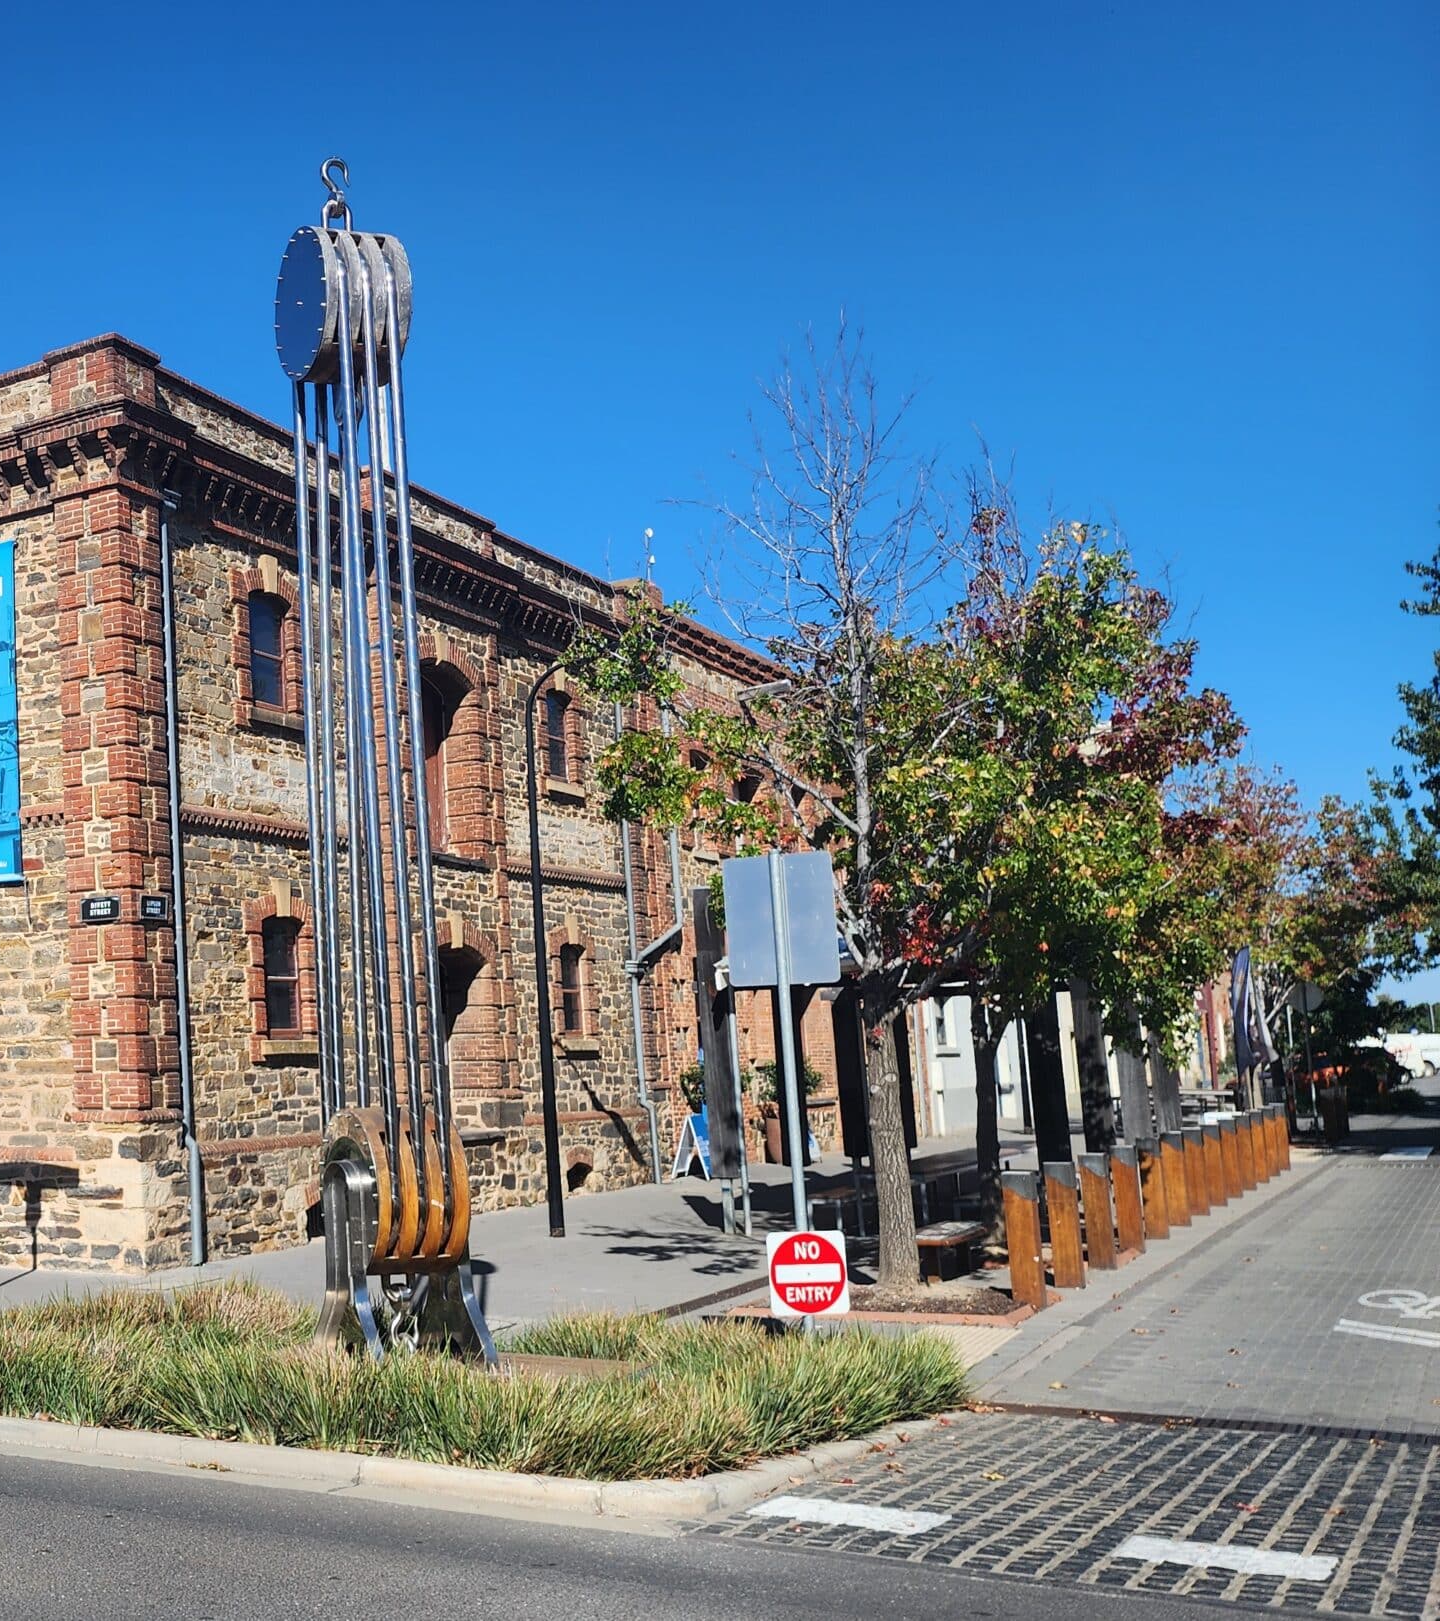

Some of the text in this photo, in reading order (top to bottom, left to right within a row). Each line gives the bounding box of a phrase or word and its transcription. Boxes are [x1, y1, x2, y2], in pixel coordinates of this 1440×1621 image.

[90, 900, 111, 909] DIVETT
[89, 908, 111, 916] STREET
[793, 1240, 820, 1260] NO
[785, 1286, 835, 1304] ENTRY
